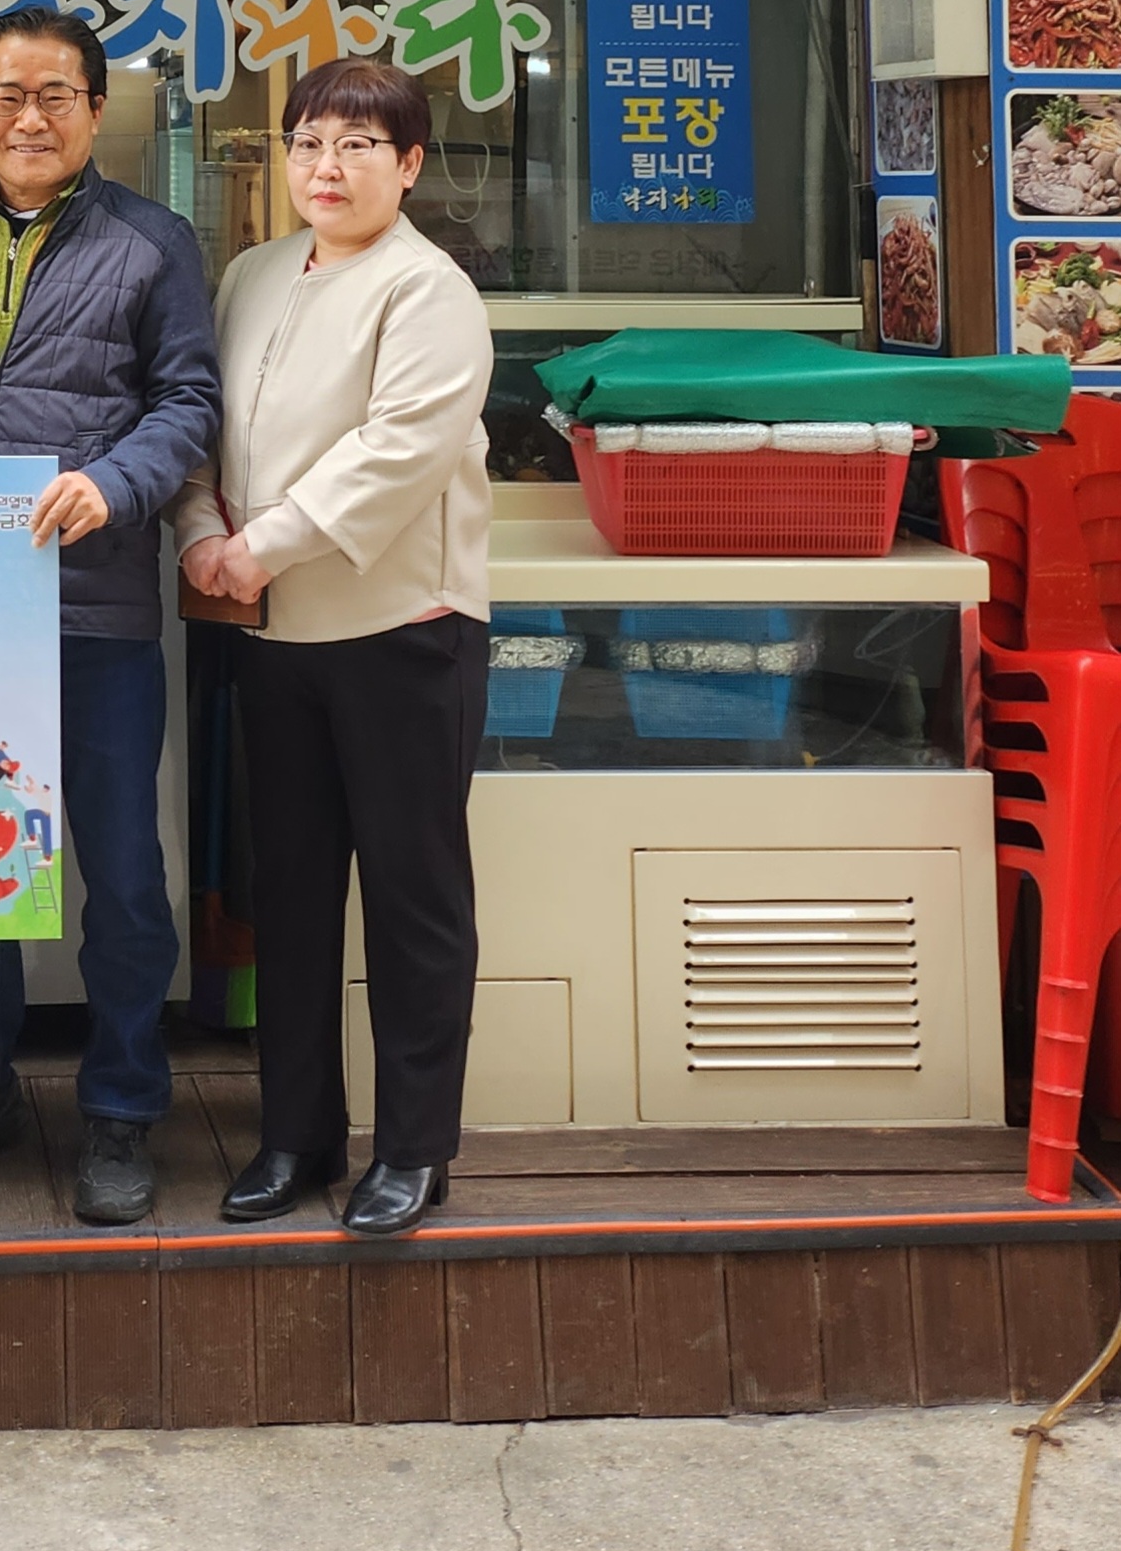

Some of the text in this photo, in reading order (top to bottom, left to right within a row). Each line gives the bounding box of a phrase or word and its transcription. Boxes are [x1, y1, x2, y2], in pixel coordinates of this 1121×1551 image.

[631, 4, 713, 30] 됩니다
[605, 57, 735, 88] 모든메뉴
[621, 98, 725, 148] 포장
[632, 152, 714, 179] 됩니다
[622, 186, 720, 212] 낙지나라
